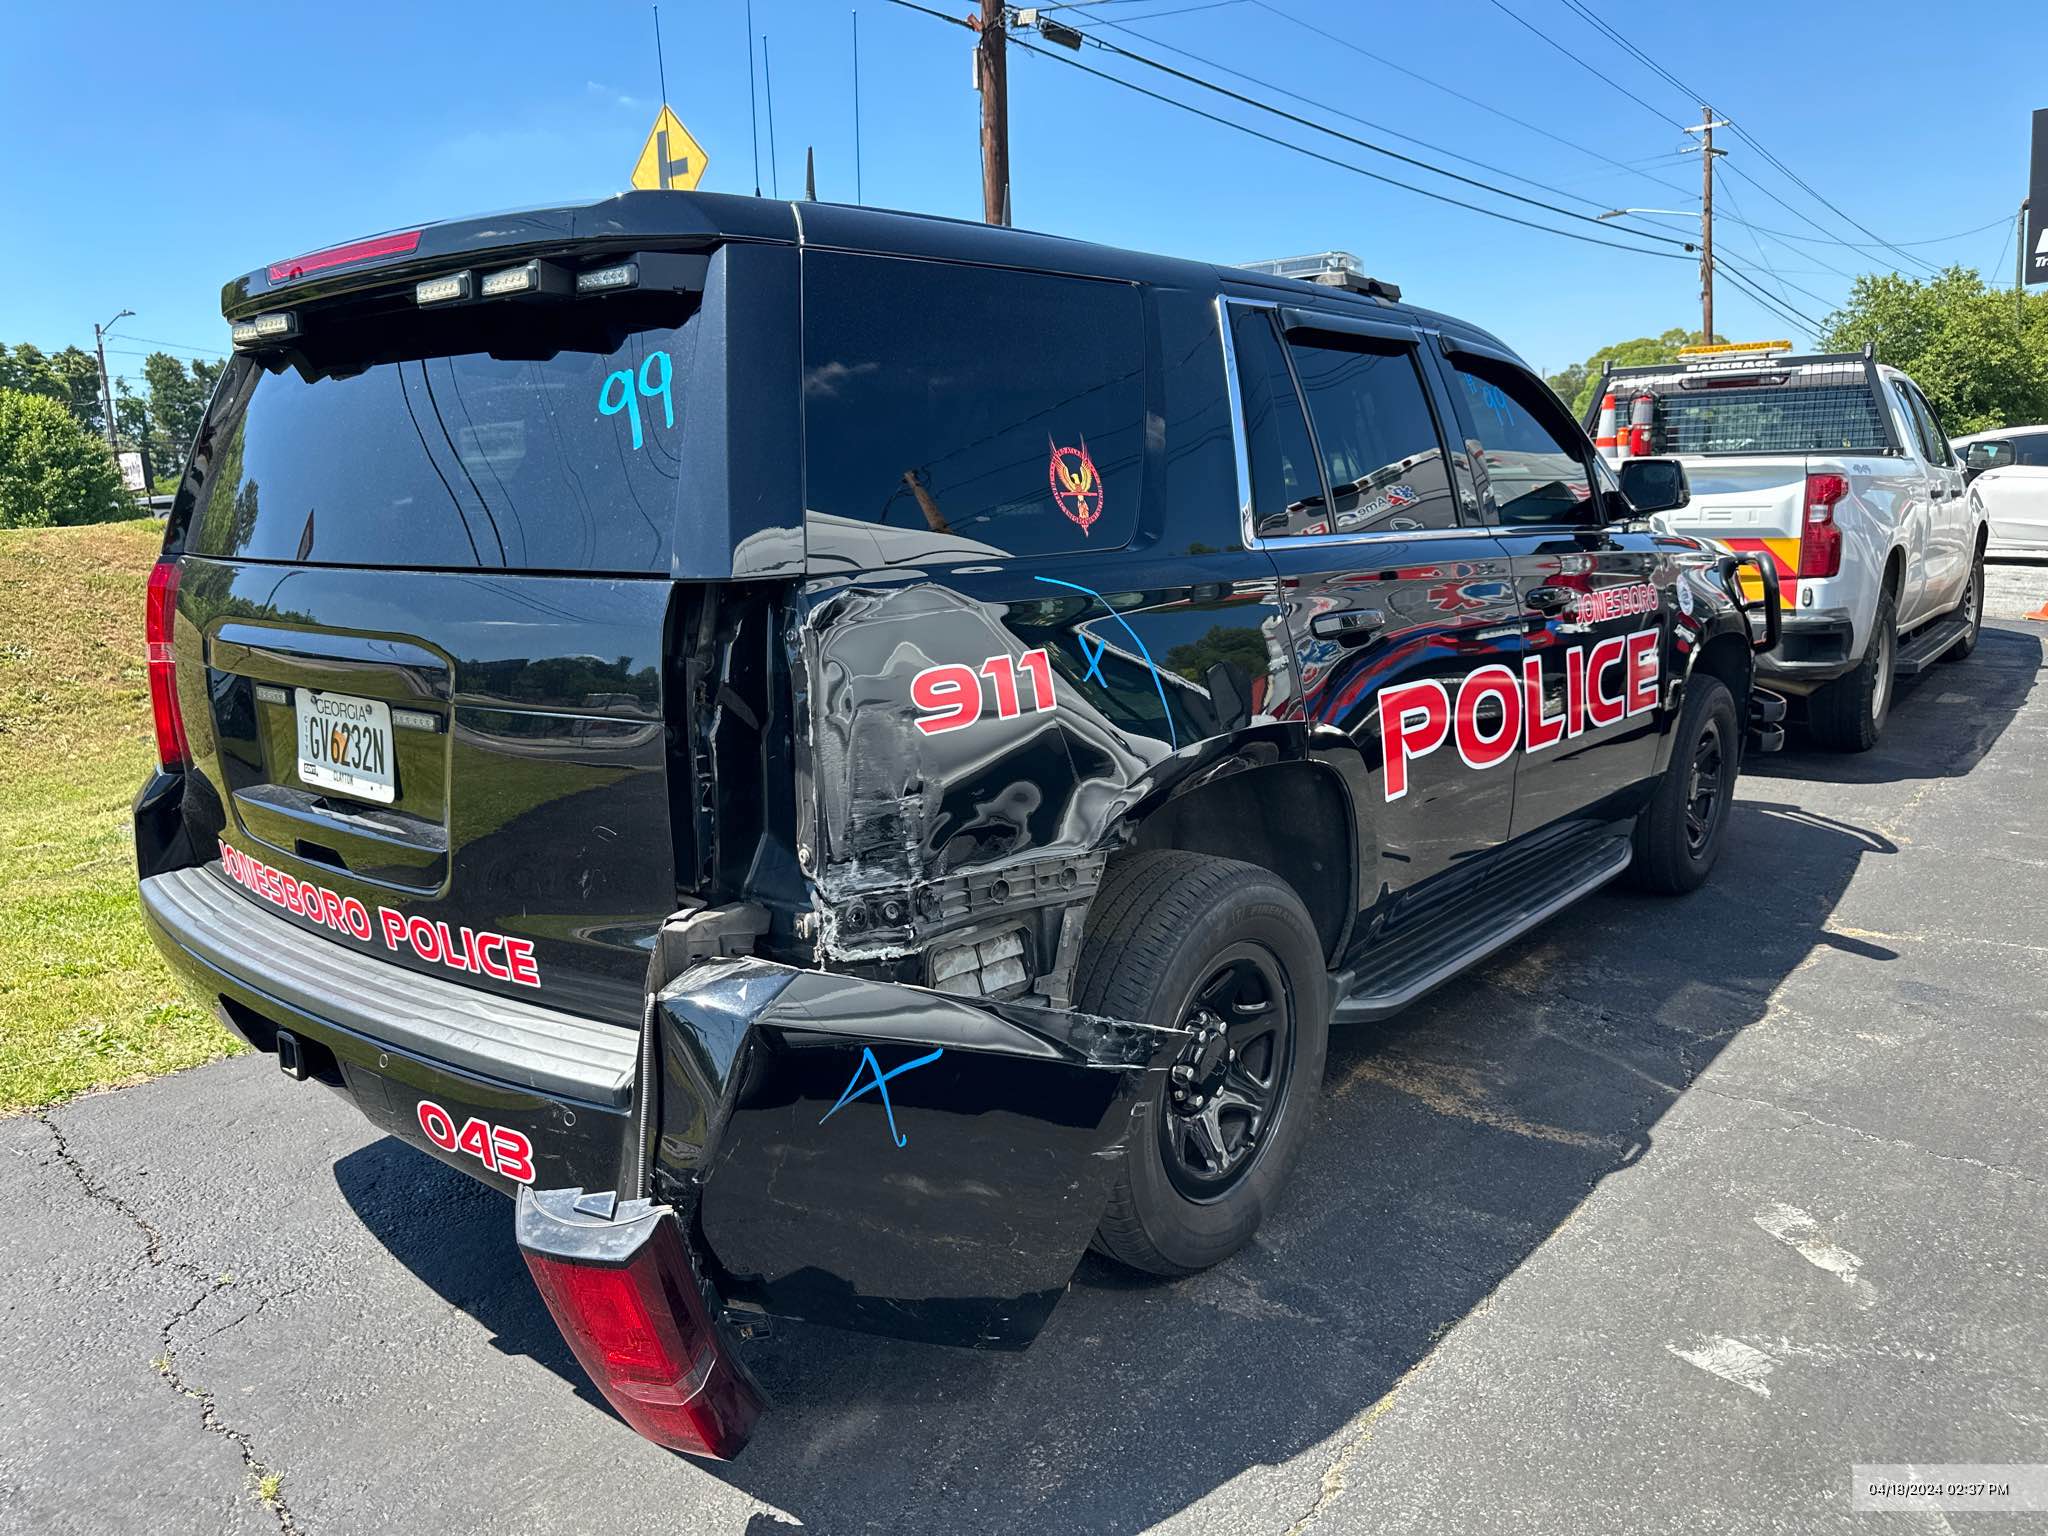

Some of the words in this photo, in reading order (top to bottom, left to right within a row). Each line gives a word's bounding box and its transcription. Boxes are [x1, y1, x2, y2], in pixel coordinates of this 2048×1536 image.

[599, 351, 674, 450] 99
[1576, 582, 1659, 625] JONESBORO
[316, 698, 367, 722] GEORGIA
[910, 648, 1058, 736] 911
[1378, 627, 1660, 803] POLICE
[310, 716, 384, 775] GV6232N
[218, 838, 373, 942] JONESBORO
[378, 905, 542, 988] POLICE
[416, 1099, 537, 1185] 043
